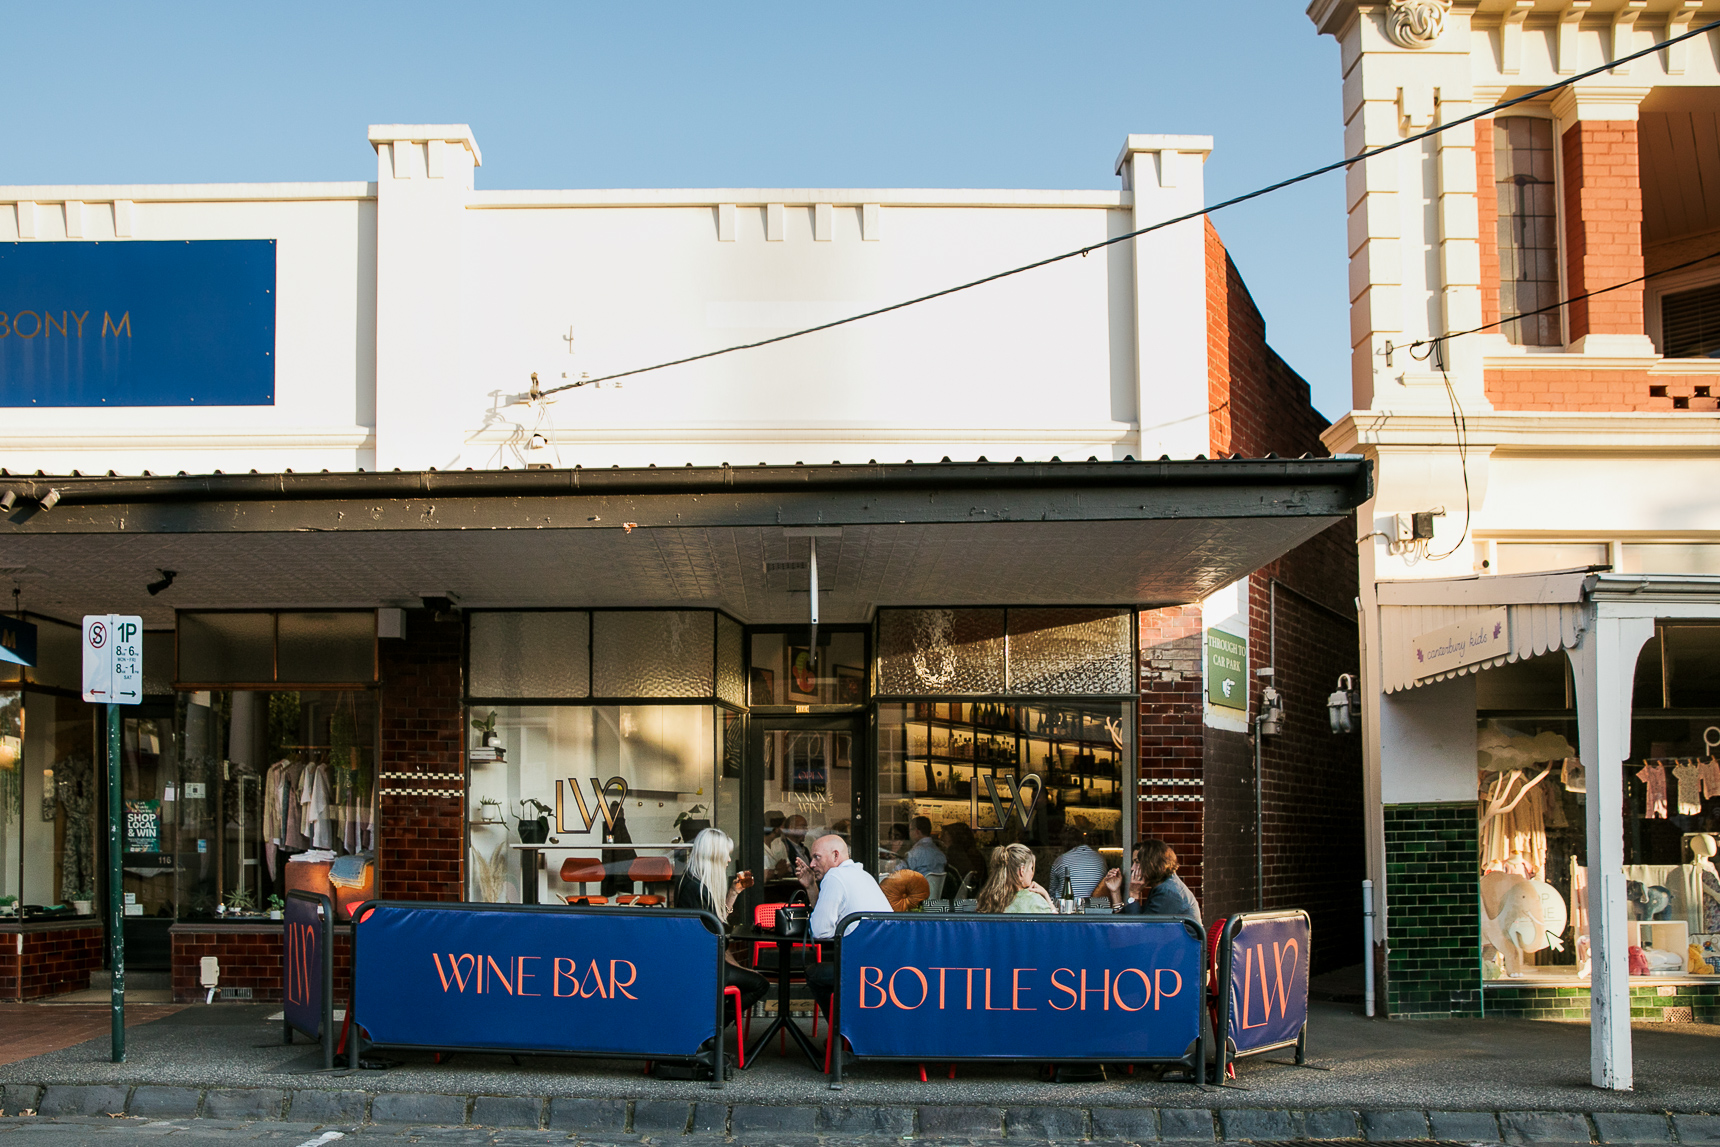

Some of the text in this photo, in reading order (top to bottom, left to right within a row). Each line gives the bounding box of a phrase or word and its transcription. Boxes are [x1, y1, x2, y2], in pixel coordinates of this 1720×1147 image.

[0, 310, 132, 339] BONY M
[117, 623, 137, 643] 1P
[1427, 627, 1488, 658] canterbury kids
[1208, 635, 1246, 657] THROUGH TO
[1213, 654, 1241, 673] CAR PARK
[127, 813, 157, 822] SHOP
[798, 803, 825, 813] WINE
[127, 829, 157, 837] & WIN
[158, 856, 172, 864] 116
[432, 953, 639, 1001] WINE BAR
[859, 966, 1183, 1012] BOTTLE SHOP
